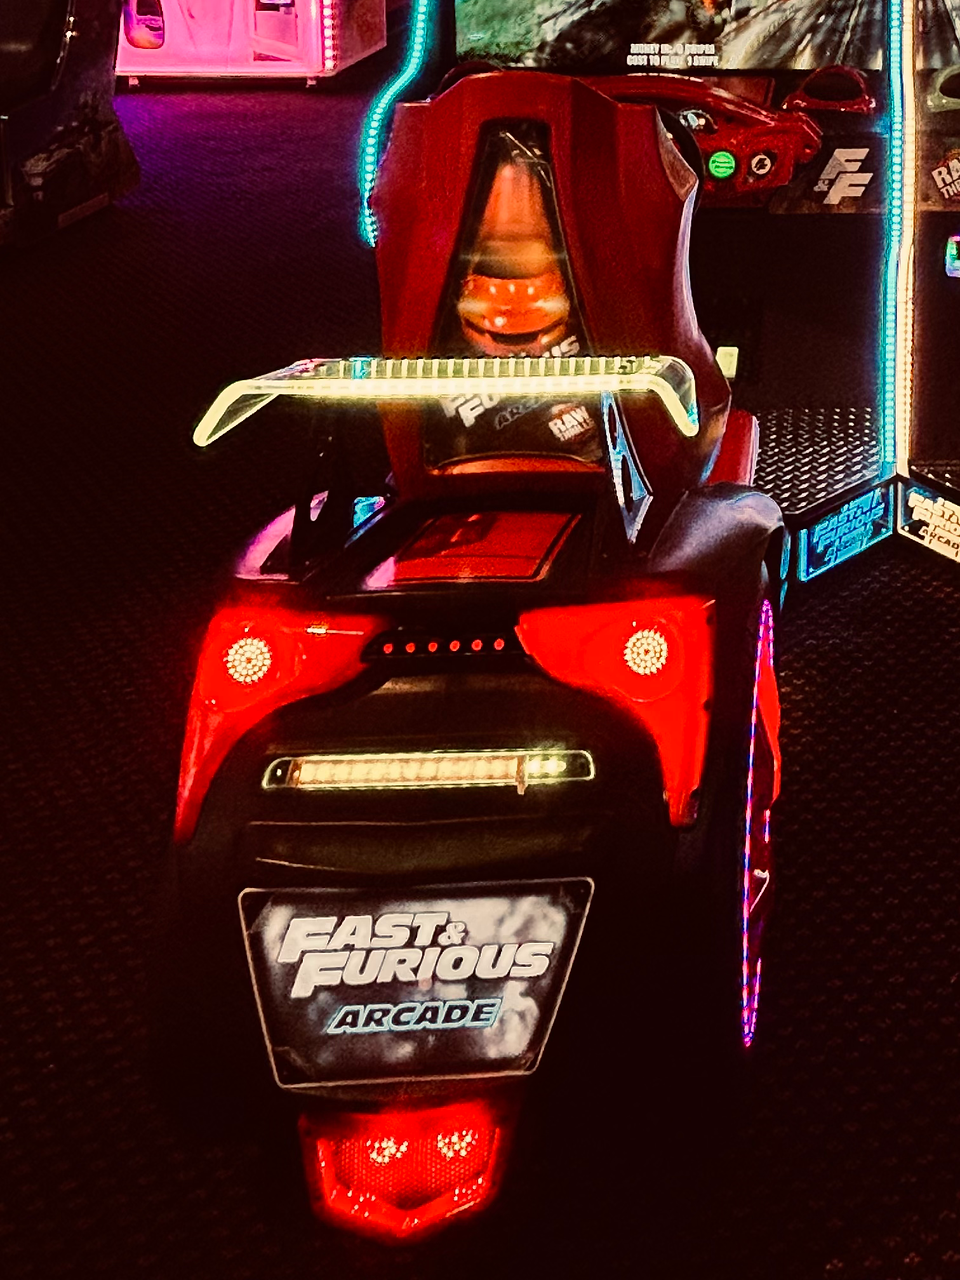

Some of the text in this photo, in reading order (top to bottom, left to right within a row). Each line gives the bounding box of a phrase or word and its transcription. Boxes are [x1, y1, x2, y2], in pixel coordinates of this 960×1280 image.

[548, 405, 591, 434] RAW
[290, 942, 555, 1000] FURIOUS
[324, 996, 504, 1035] ARCADE
